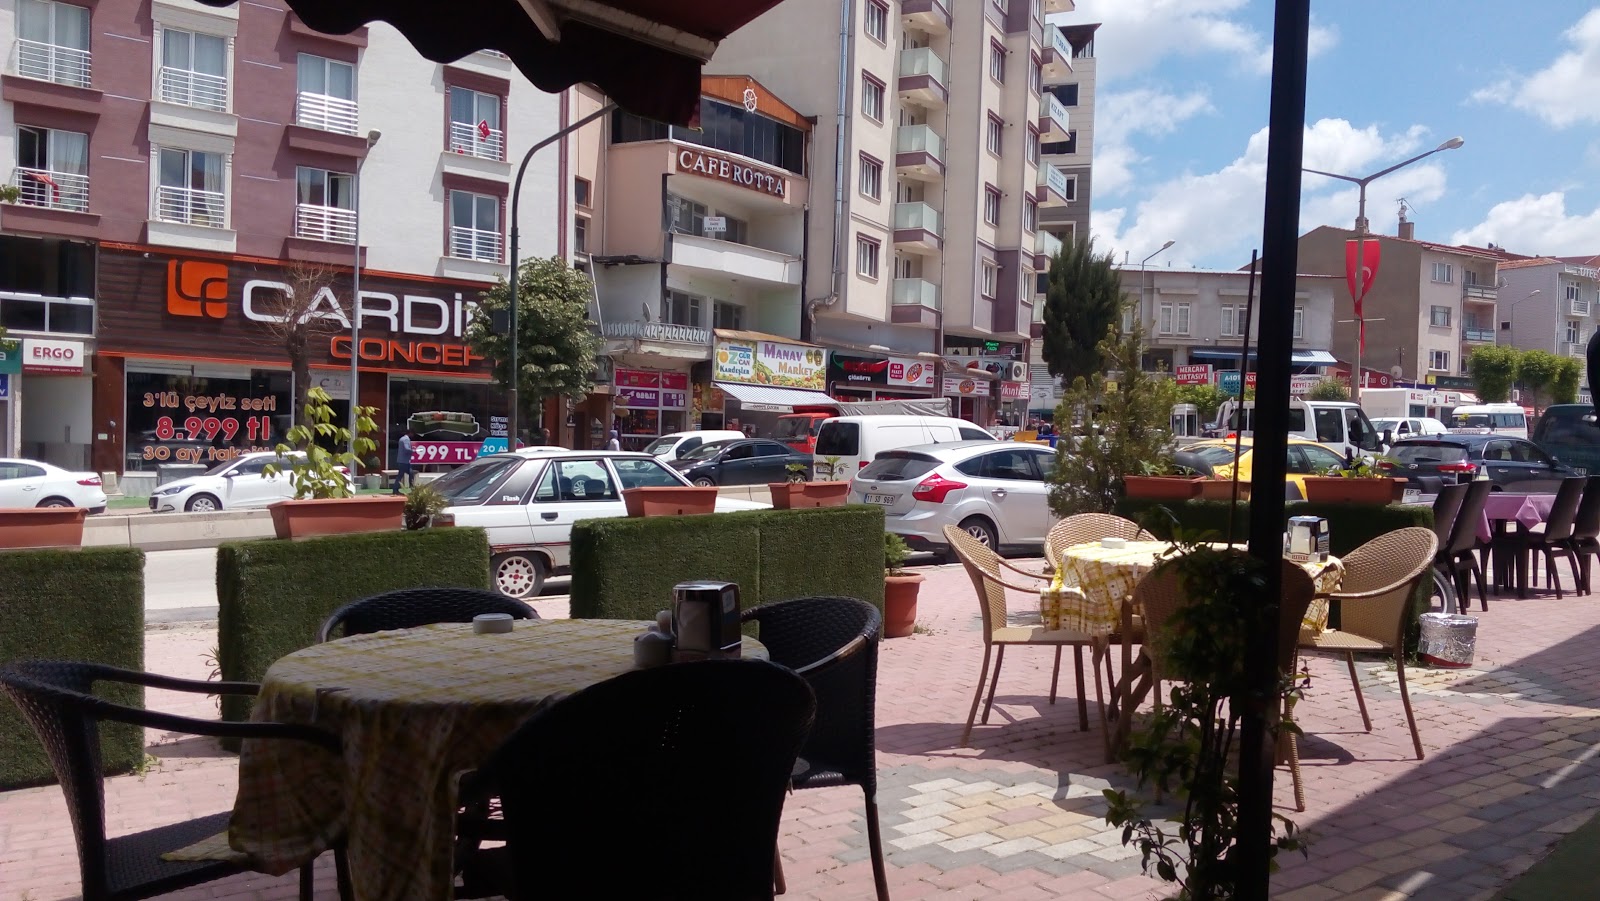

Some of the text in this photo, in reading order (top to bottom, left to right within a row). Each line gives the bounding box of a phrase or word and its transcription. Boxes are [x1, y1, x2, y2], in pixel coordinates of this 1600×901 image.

[680, 151, 785, 196] CAFE ROTTA
[33, 347, 74, 359] ERGO
[184, 393, 236, 413] çeyiz
[241, 395, 277, 411] seti
[156, 415, 271, 441] 8.999 tl
[176, 447, 203, 464] ay
[455, 448, 472, 460] TL
[483, 445, 496, 453] 20
